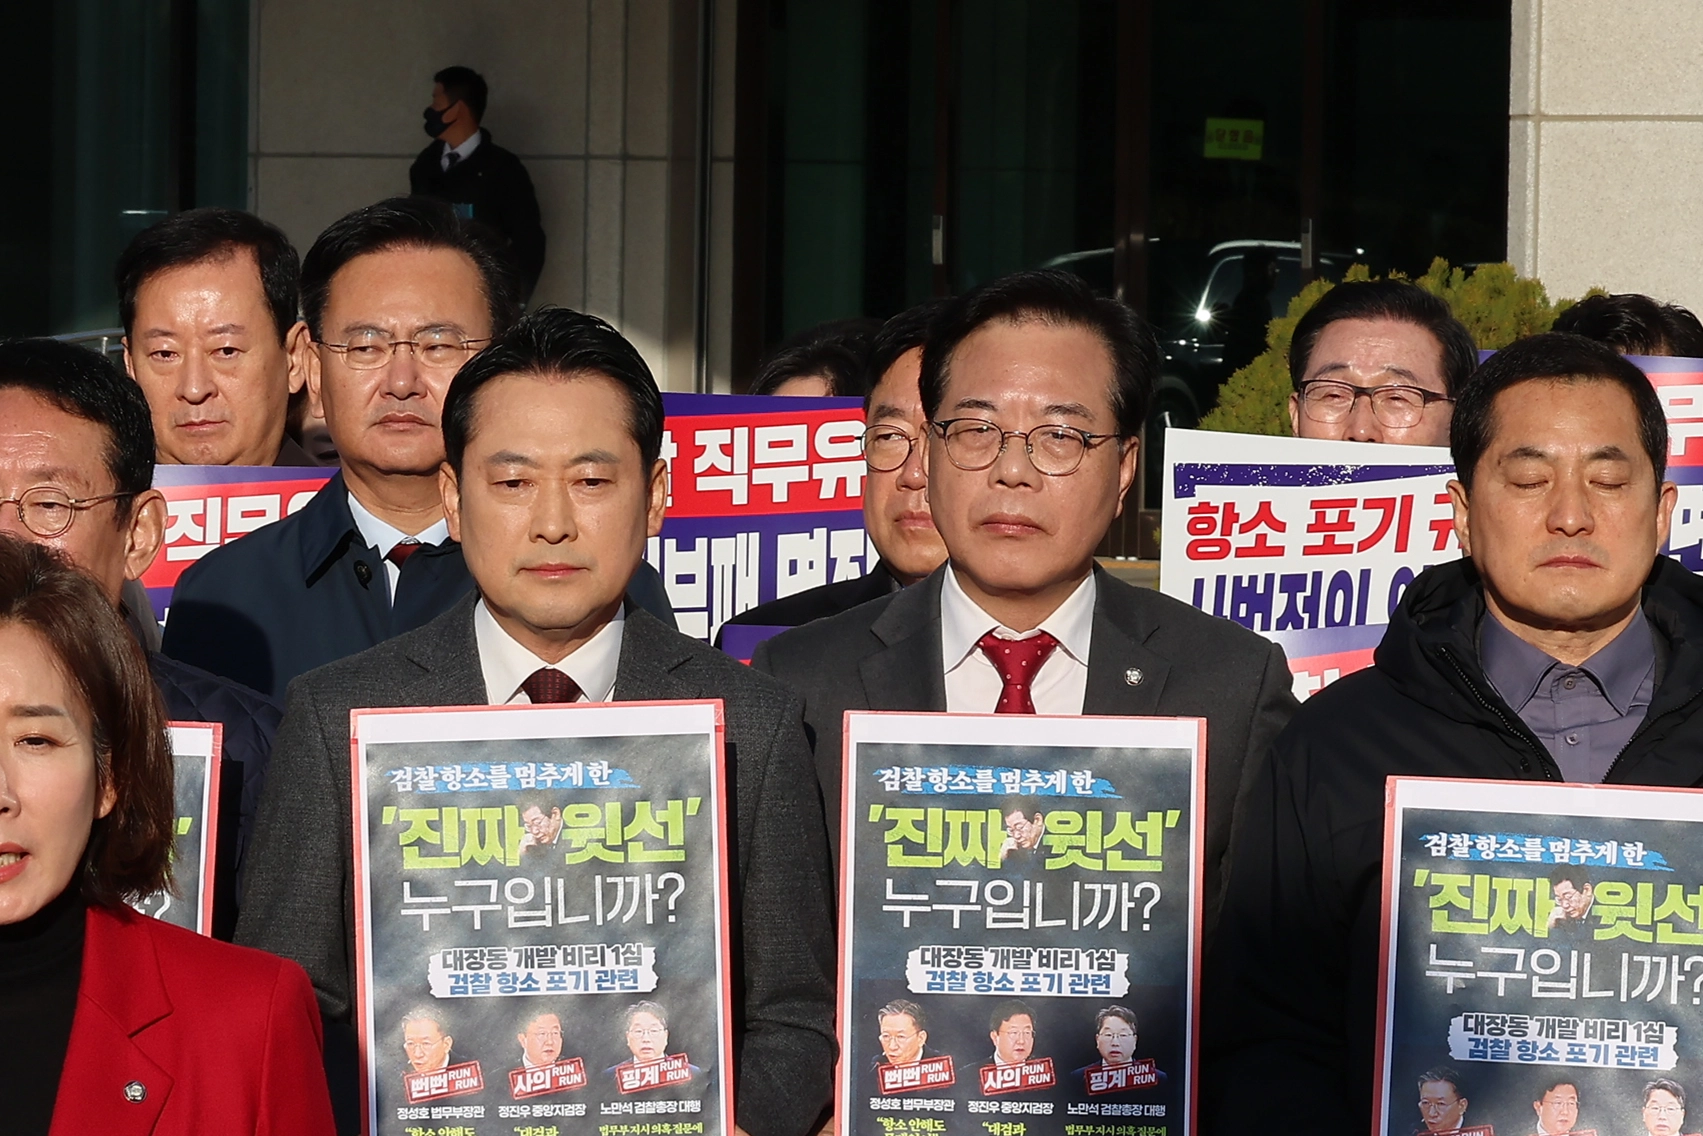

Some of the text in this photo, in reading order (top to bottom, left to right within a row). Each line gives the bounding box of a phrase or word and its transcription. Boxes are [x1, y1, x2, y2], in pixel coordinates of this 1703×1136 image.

[1186, 501, 1287, 561] 항소
[1302, 494, 1414, 556] 포기
[390, 760, 614, 792] 검찰 항소를 멈추게 한
[878, 766, 1096, 795] 검찰 항소를 멈추게 한
[381, 797, 703, 870] '진짜 윗선'
[867, 804, 1181, 872] '진짜 윗선'
[1424, 831, 1648, 867] 검찰 항소를 멈추게 한
[399, 872, 686, 931] 누구입니까?
[882, 877, 1161, 932] 누구입니까?
[1411, 868, 1555, 938] '진짜
[442, 943, 642, 971] 대장동 개발 비리 1심
[920, 946, 1116, 971] 대장동 개발 비리 1심
[448, 968, 638, 995] 검찰 항소 포기 관련
[925, 970, 1110, 994] 검찰 항소 포기 관련
[1463, 1012, 1664, 1044] 대장동 개발 비리 1심
[1467, 1037, 1658, 1067] 검찰 항소 포기 관련
[448, 1068, 470, 1079] RUN
[552, 1064, 574, 1075] RUN
[659, 1059, 681, 1070] RUN
[666, 1068, 688, 1080] RUN
[921, 1062, 942, 1073] RUN
[1022, 1064, 1044, 1074] RUN
[1127, 1064, 1149, 1074] RUN
[411, 1072, 448, 1098] 뻔뻔
[454, 1078, 477, 1088] RUN
[513, 1069, 551, 1093] 사의
[558, 1074, 581, 1085] RUN
[622, 1065, 659, 1089] 핑계
[884, 1065, 921, 1089] 뻔뻔
[927, 1072, 948, 1082] RUN
[984, 1067, 1020, 1090] 사의
[1028, 1073, 1050, 1084] RUN
[1090, 1068, 1126, 1091] 핑계
[1133, 1073, 1155, 1084] RUN
[397, 1105, 485, 1120] 정성호 법무부장관
[497, 1103, 586, 1118] 정진우 중앙지검장
[600, 1099, 701, 1115] 노만석 검찰총장 대행
[869, 1097, 955, 1111] 정성호 법무부장관
[967, 1100, 1053, 1114] 정진우 중앙지검장
[1067, 1102, 1165, 1116] 노만석 검찰총장 대행
